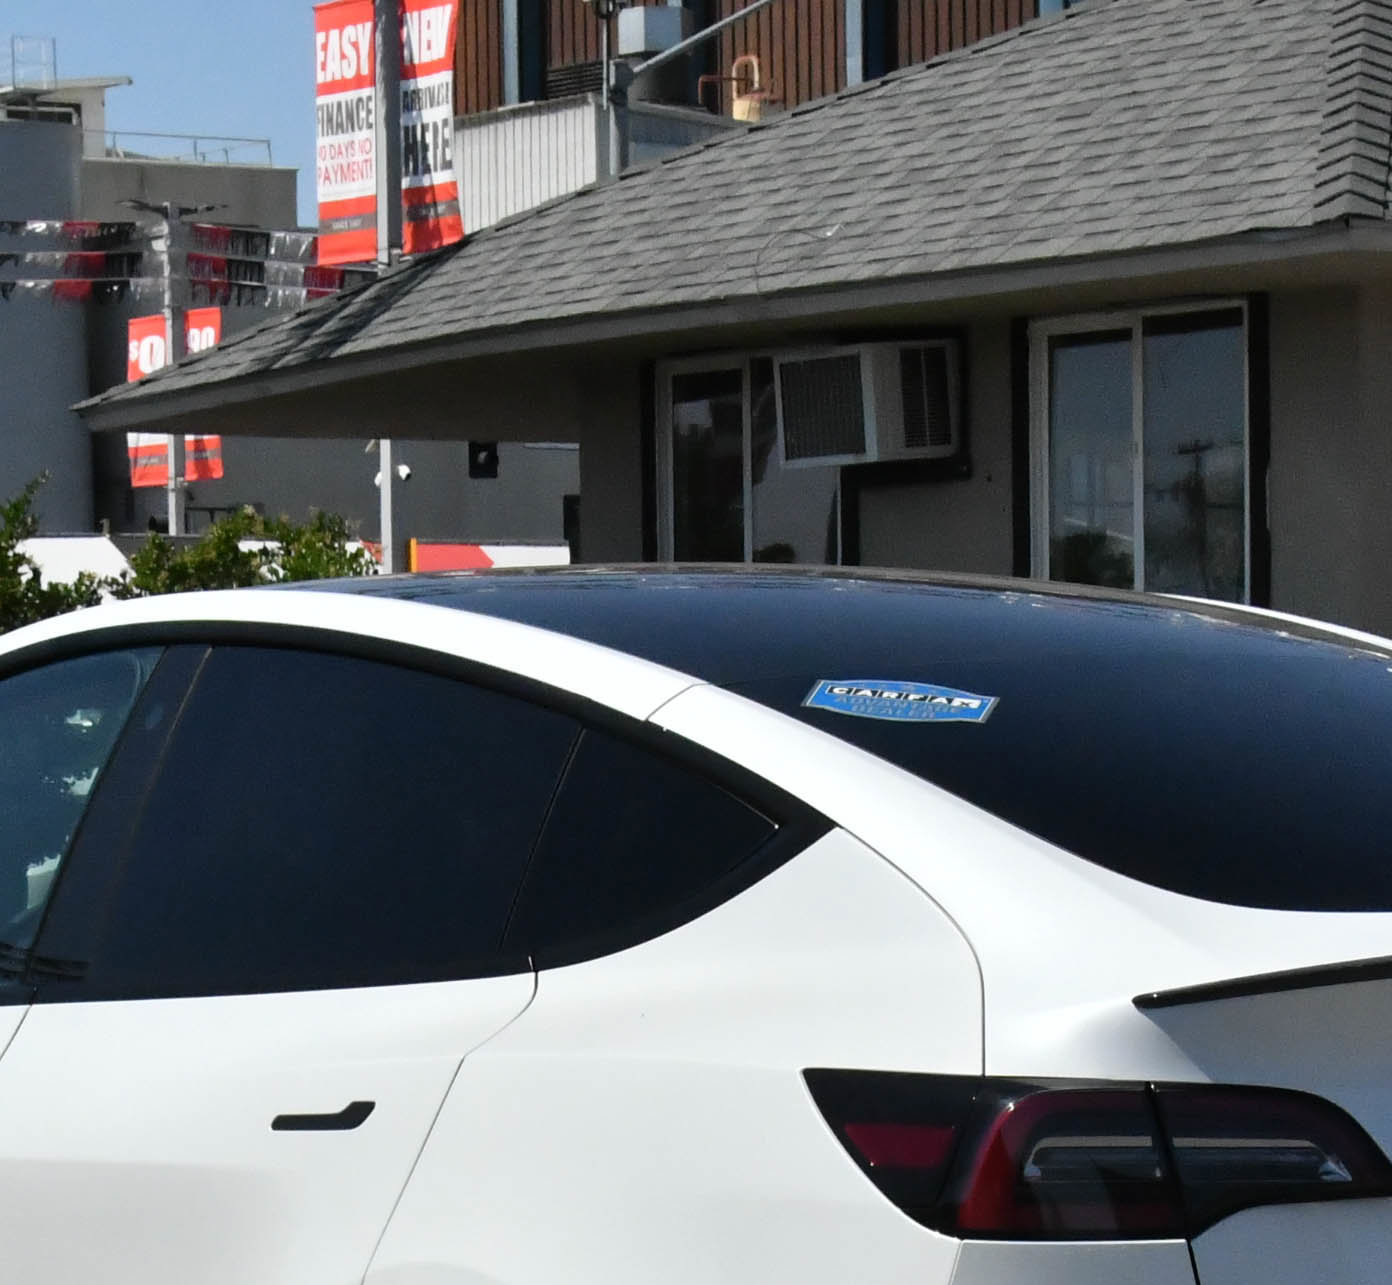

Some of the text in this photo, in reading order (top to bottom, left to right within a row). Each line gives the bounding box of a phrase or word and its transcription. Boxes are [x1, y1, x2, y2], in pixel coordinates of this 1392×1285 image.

[316, 21, 373, 83] EASY
[316, 95, 374, 137] FINANCE
[827, 685, 982, 709] CARFAX
